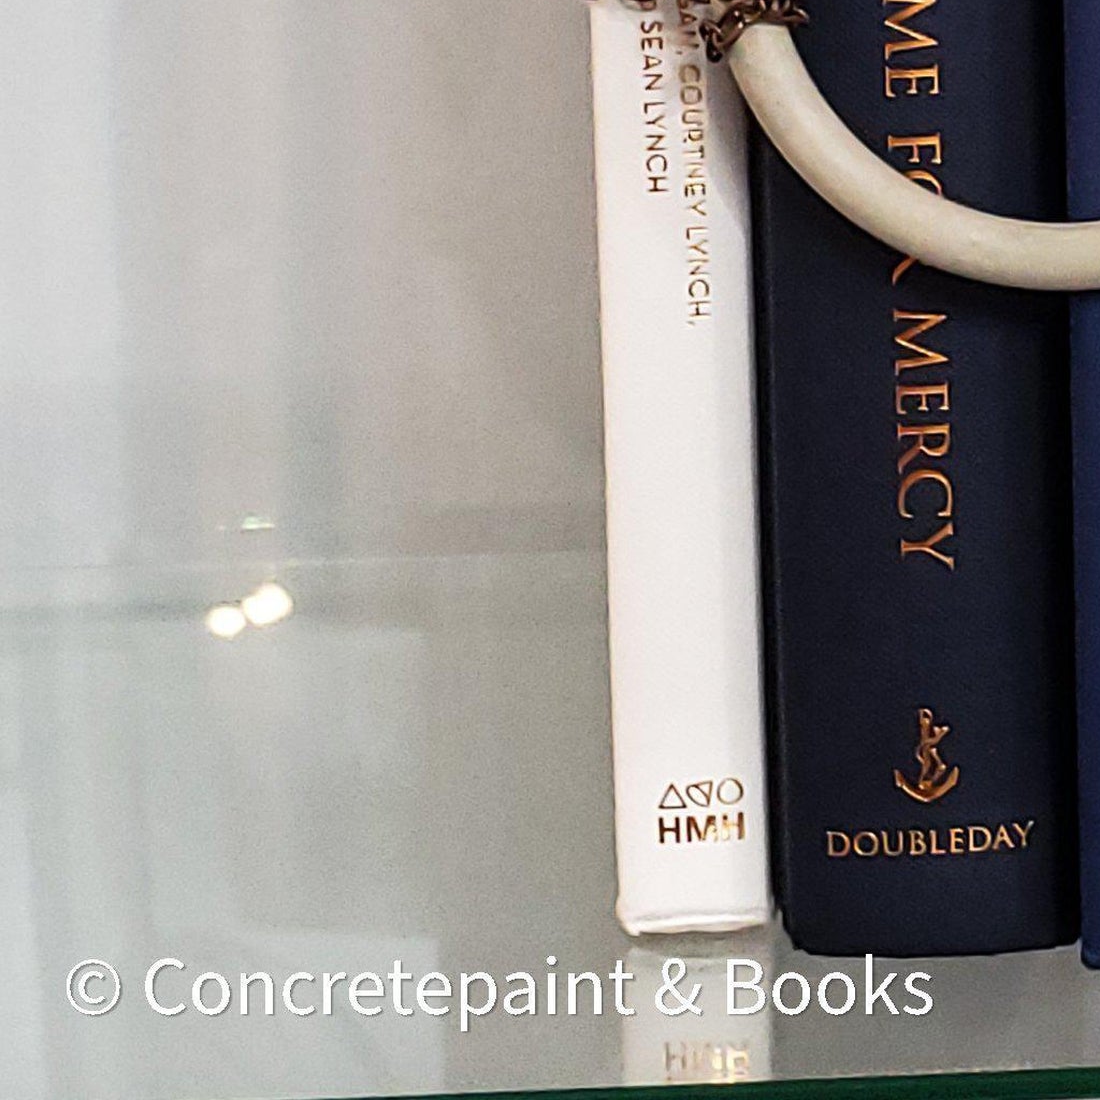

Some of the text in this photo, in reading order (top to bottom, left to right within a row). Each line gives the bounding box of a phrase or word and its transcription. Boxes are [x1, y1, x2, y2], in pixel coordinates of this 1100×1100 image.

[640, 20, 664, 91] SEAN
[643, 100, 668, 193] LYNCH
[679, 63, 707, 216] COURTNEY
[893, 308, 954, 571] MERCY
[657, 811, 746, 844] HMH
[826, 820, 1036, 857] DOUBLEDAY
